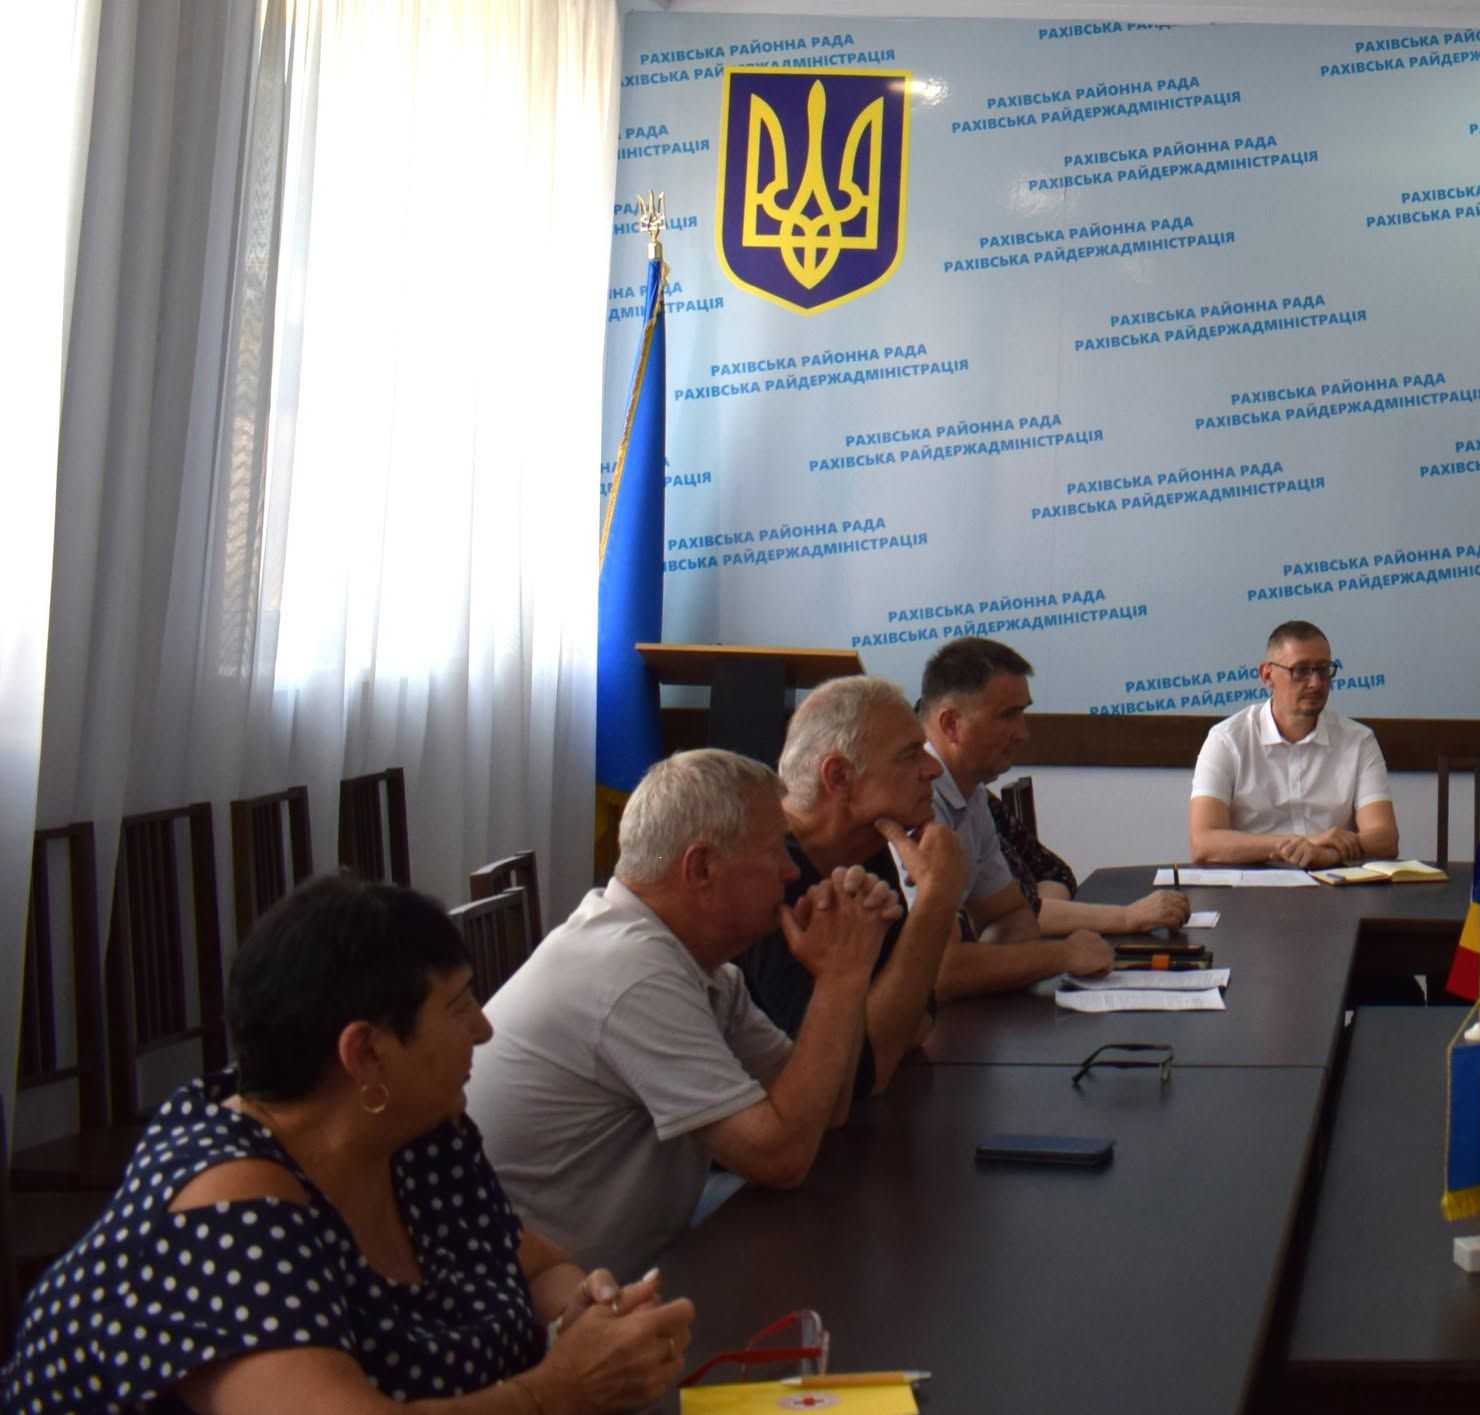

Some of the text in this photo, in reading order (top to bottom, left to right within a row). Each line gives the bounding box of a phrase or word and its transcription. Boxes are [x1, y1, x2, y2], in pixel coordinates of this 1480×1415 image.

[1038, 21, 1123, 40] РАХІВСЬКА
[1355, 35, 1439, 53] РАХІВСЬКА
[640, 34, 854, 65] РАХІВСЬКА РАЙОННА РАДА
[621, 68, 689, 88] ХІВСЬКА
[1320, 57, 1405, 77] РАХІВСЬКА
[987, 76, 1200, 109] РАХІВСЬКА РАЙОННА РАДА
[952, 90, 1241, 134] РАХІВСЬКА РАЙДЕРЖАДМІНІСТРАЦІЯ
[626, 125, 669, 140] РАДА
[1064, 135, 1277, 167] РАХІВСЬКА РАЙОННА РАДА
[1029, 150, 1318, 190] РАХІВСЬКА РАЙДЕРЖАДМІНІСТРАЦІЯ
[979, 215, 1194, 248] РАХІВСЬКА РАЙОННА РАДА
[1366, 208, 1451, 228] РАХІВСЬКА
[944, 231, 1235, 272] РАХІВСЬКА РАЙДЕРЖАДМІНІСТРАЦІЯ
[1110, 294, 1325, 328] РАХІВСЬКА РАЙОННА РАДА
[1075, 309, 1367, 352] РАХІВСЬКА РАЙДЕРЖАДМІНІСТРАЦІЯ
[710, 344, 927, 377] РАХІВСЬКА РАЙОННА РАДА
[675, 359, 969, 400] РАХІВСЬКА РАЙДЕРЖАДМІНІСТРАЦІЯ
[1231, 372, 1446, 406] РАХІВСЬКА РАЙОННА РАДА
[845, 414, 1062, 447] РАХІВСЬКА РАЙОННА РАДА
[1195, 410, 1281, 430] РАХІВСЬКА
[809, 429, 1103, 472] РАХІВСЬКА РАЙДЕРЖАДМІНІСТРАЦІЯ
[1067, 461, 1283, 495] РАХІВСЬКА РАЙОННА РАДА
[1032, 476, 1325, 520] РАХІВСЬКА РАЙДЕРЖАДМІНІСТРАЦІЯ
[668, 517, 885, 550] РАХІВСЬКА РАЙОННА РАДА
[723, 533, 927, 566] РАЙДЕРЖАДМІНІСТРАЦІЯ
[1283, 556, 1369, 577] РАХІВСЬКА
[1373, 547, 1452, 567] РАЙОННА
[888, 589, 1105, 623] РАХІВСЬКА РАЙОННА РАДА
[1247, 581, 1334, 601] РАХІВСЬКА
[852, 604, 1147, 648] РАХІВСЬКА РАЙДЕРЖАДМІНІСТРАЦІЯ
[1125, 672, 1213, 693] РАХІВСЬКА
